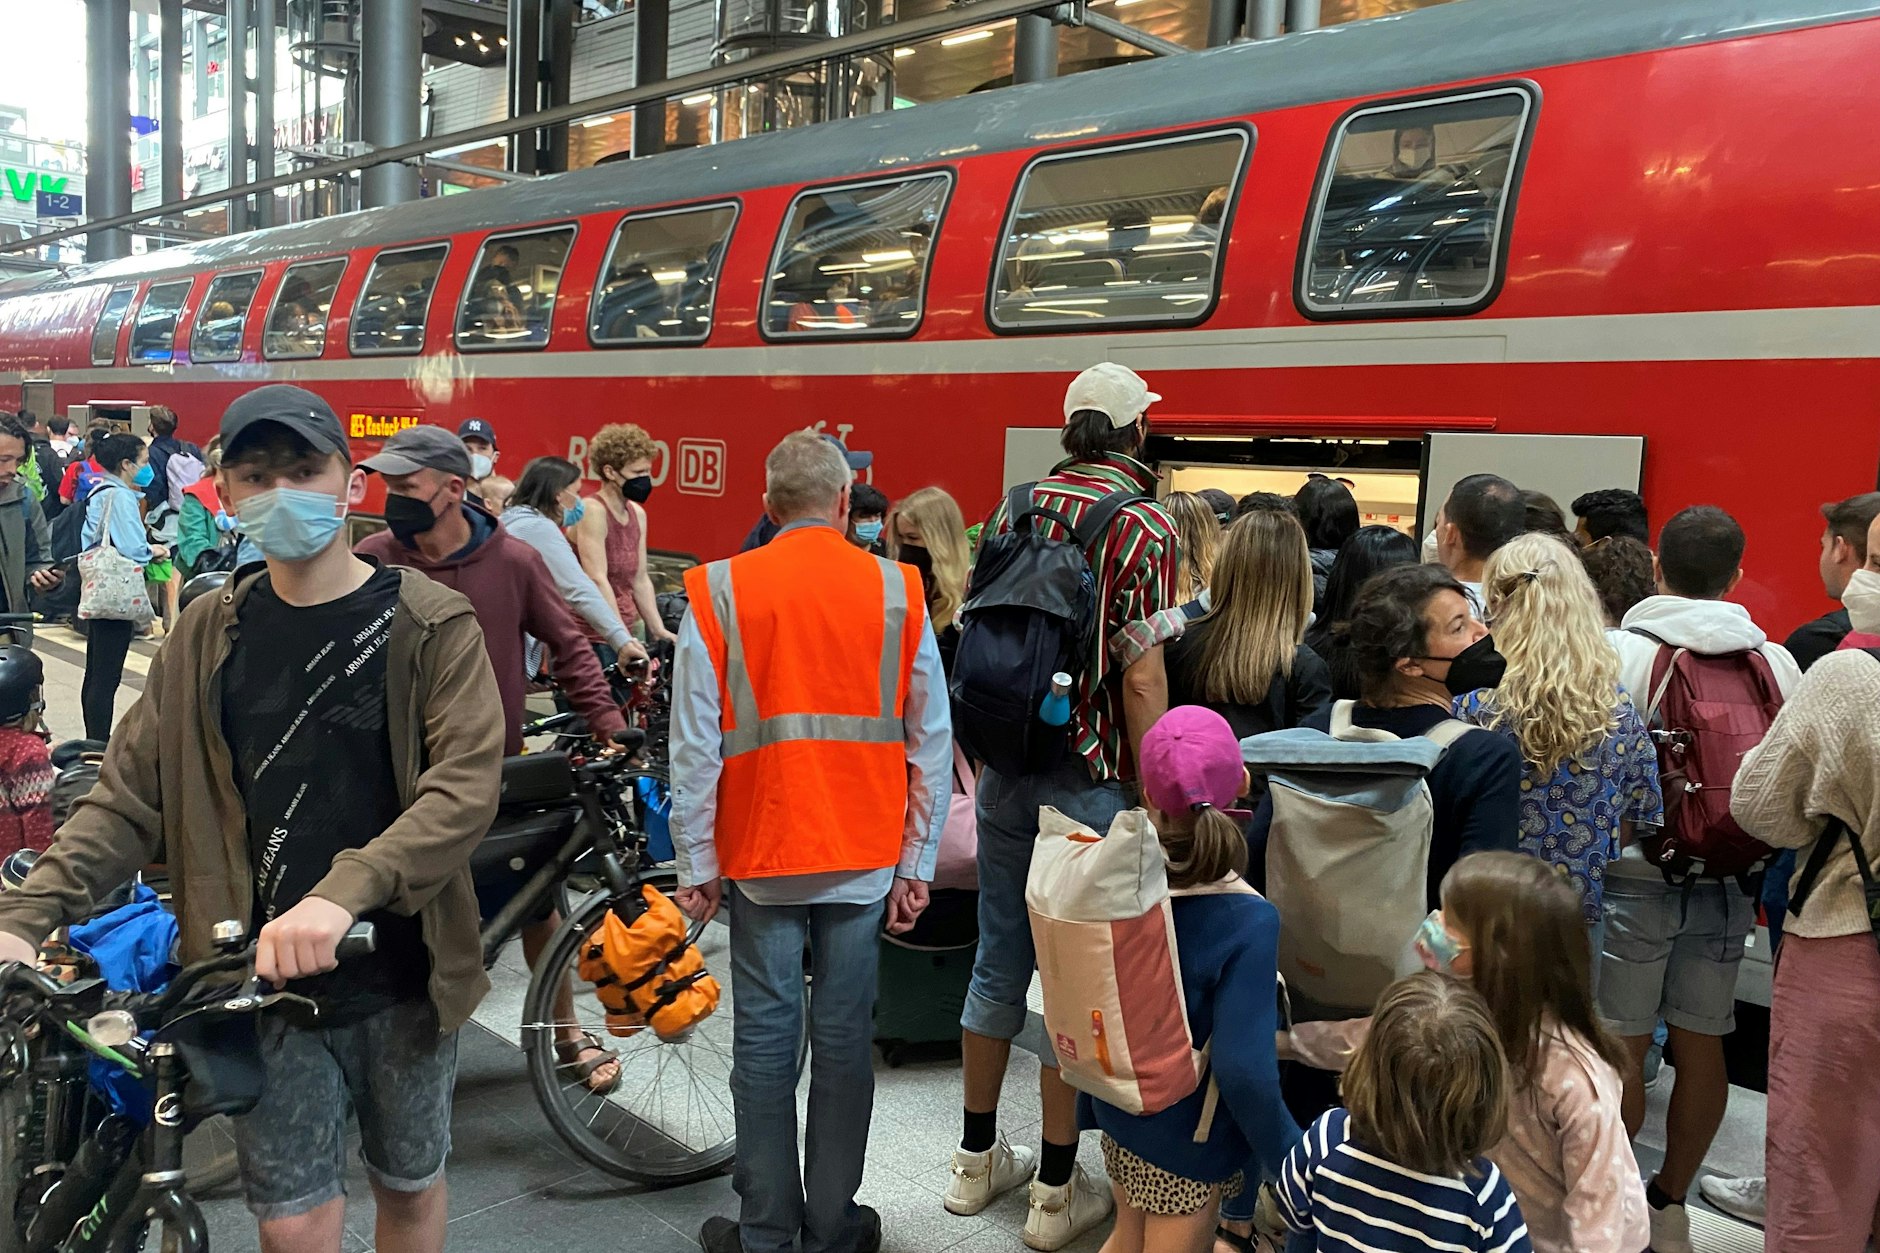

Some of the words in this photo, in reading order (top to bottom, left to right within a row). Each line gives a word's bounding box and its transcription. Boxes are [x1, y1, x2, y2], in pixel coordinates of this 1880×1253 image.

[45, 194, 70, 209] 1-2
[366, 415, 399, 437] Rostock
[681, 444, 722, 490] DB
[352, 617, 385, 647] ARMANI
[345, 645, 377, 677] ARMANI
[263, 826, 288, 871] JEANS
